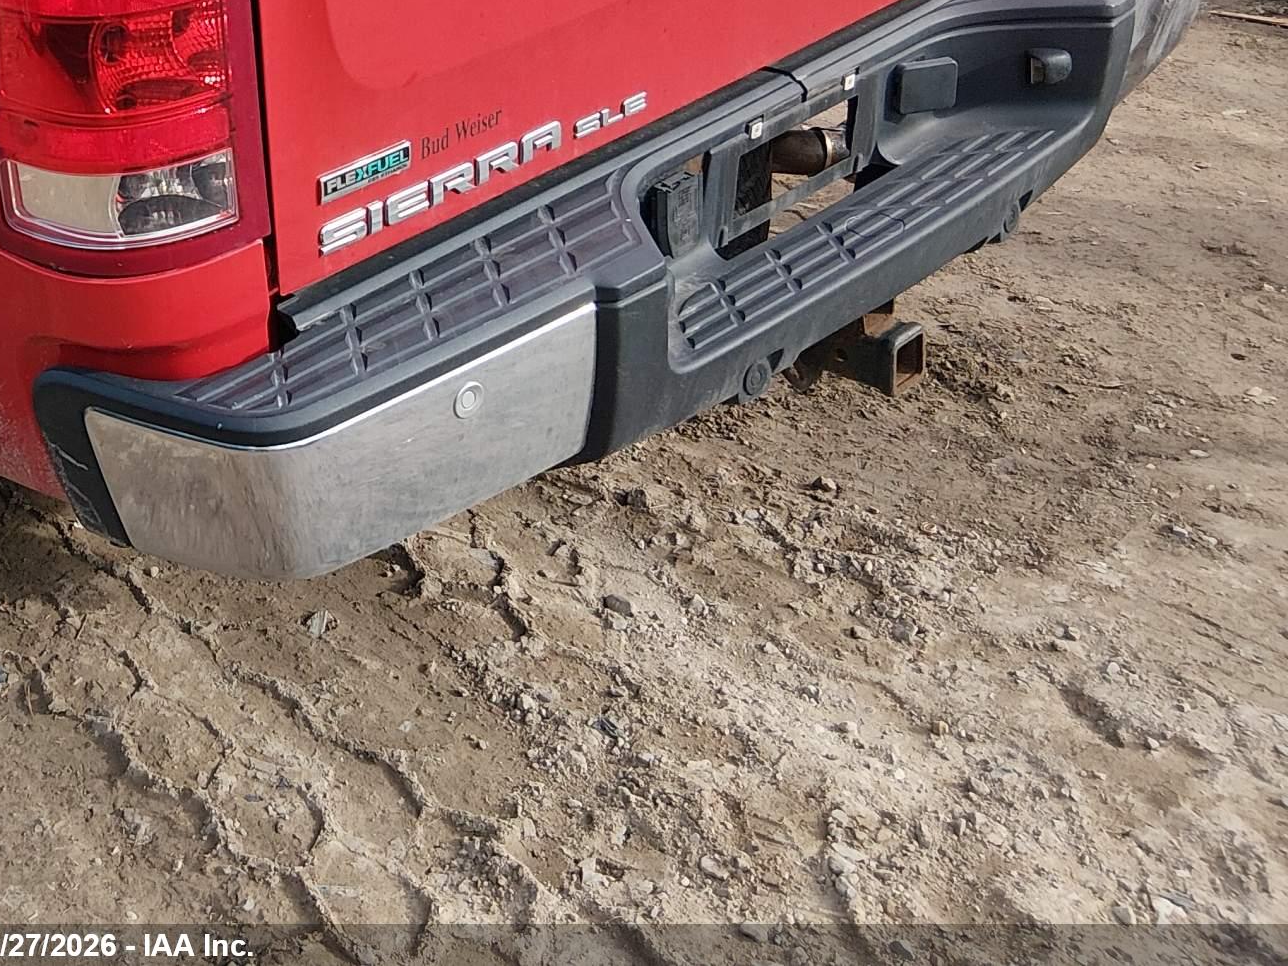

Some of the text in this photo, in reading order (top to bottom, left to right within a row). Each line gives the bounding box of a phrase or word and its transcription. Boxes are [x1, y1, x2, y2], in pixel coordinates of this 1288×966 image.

[421, 109, 502, 160] Bud Weiser
[318, 91, 647, 257] SIERRA SLE
[327, 149, 409, 194] FLEXFUEL
